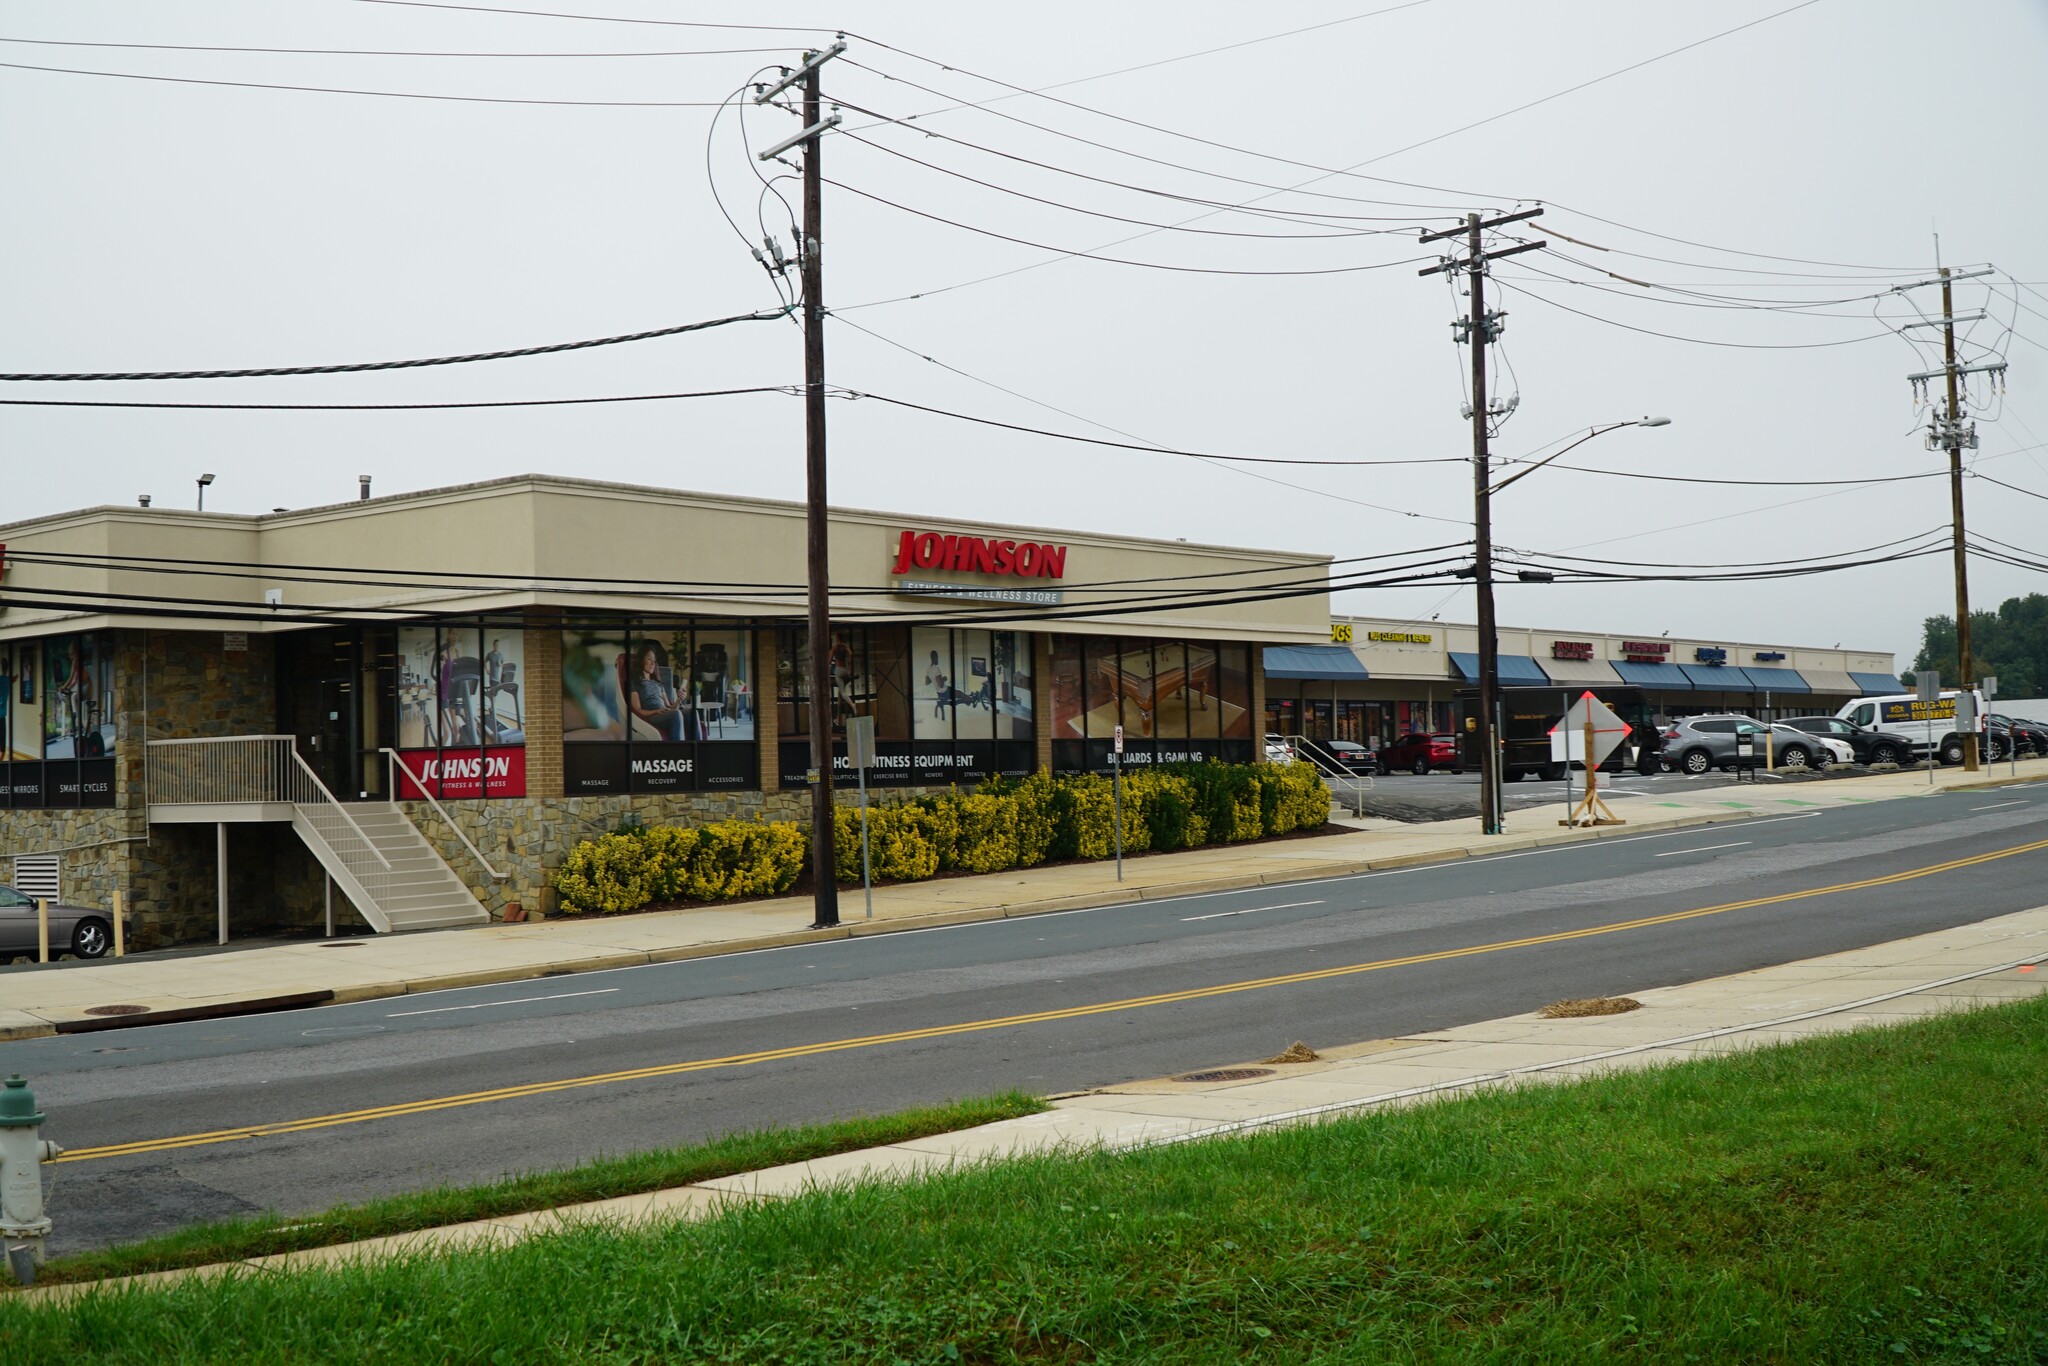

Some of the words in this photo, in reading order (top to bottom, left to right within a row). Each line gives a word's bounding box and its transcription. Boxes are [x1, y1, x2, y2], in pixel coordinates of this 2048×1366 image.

[892, 531, 1067, 578] JOHNSON
[968, 589, 1021, 601] WELLNESS
[1025, 591, 1057, 603] STORE
[1911, 700, 1956, 710] RUG-WA
[833, 756, 850, 769] HO
[914, 755, 974, 767] EQUIPMENT
[1107, 752, 1152, 764] BILIARDS
[1157, 752, 1164, 763] &
[1165, 752, 1203, 763] GAMING
[420, 756, 510, 784] JOHNSON
[631, 759, 694, 774] MASSAGE
[708, 776, 744, 784] ACCESSORIES
[14, 785, 39, 794] MIRRORS
[59, 784, 80, 793] SMART
[83, 783, 108, 793] CYCLES
